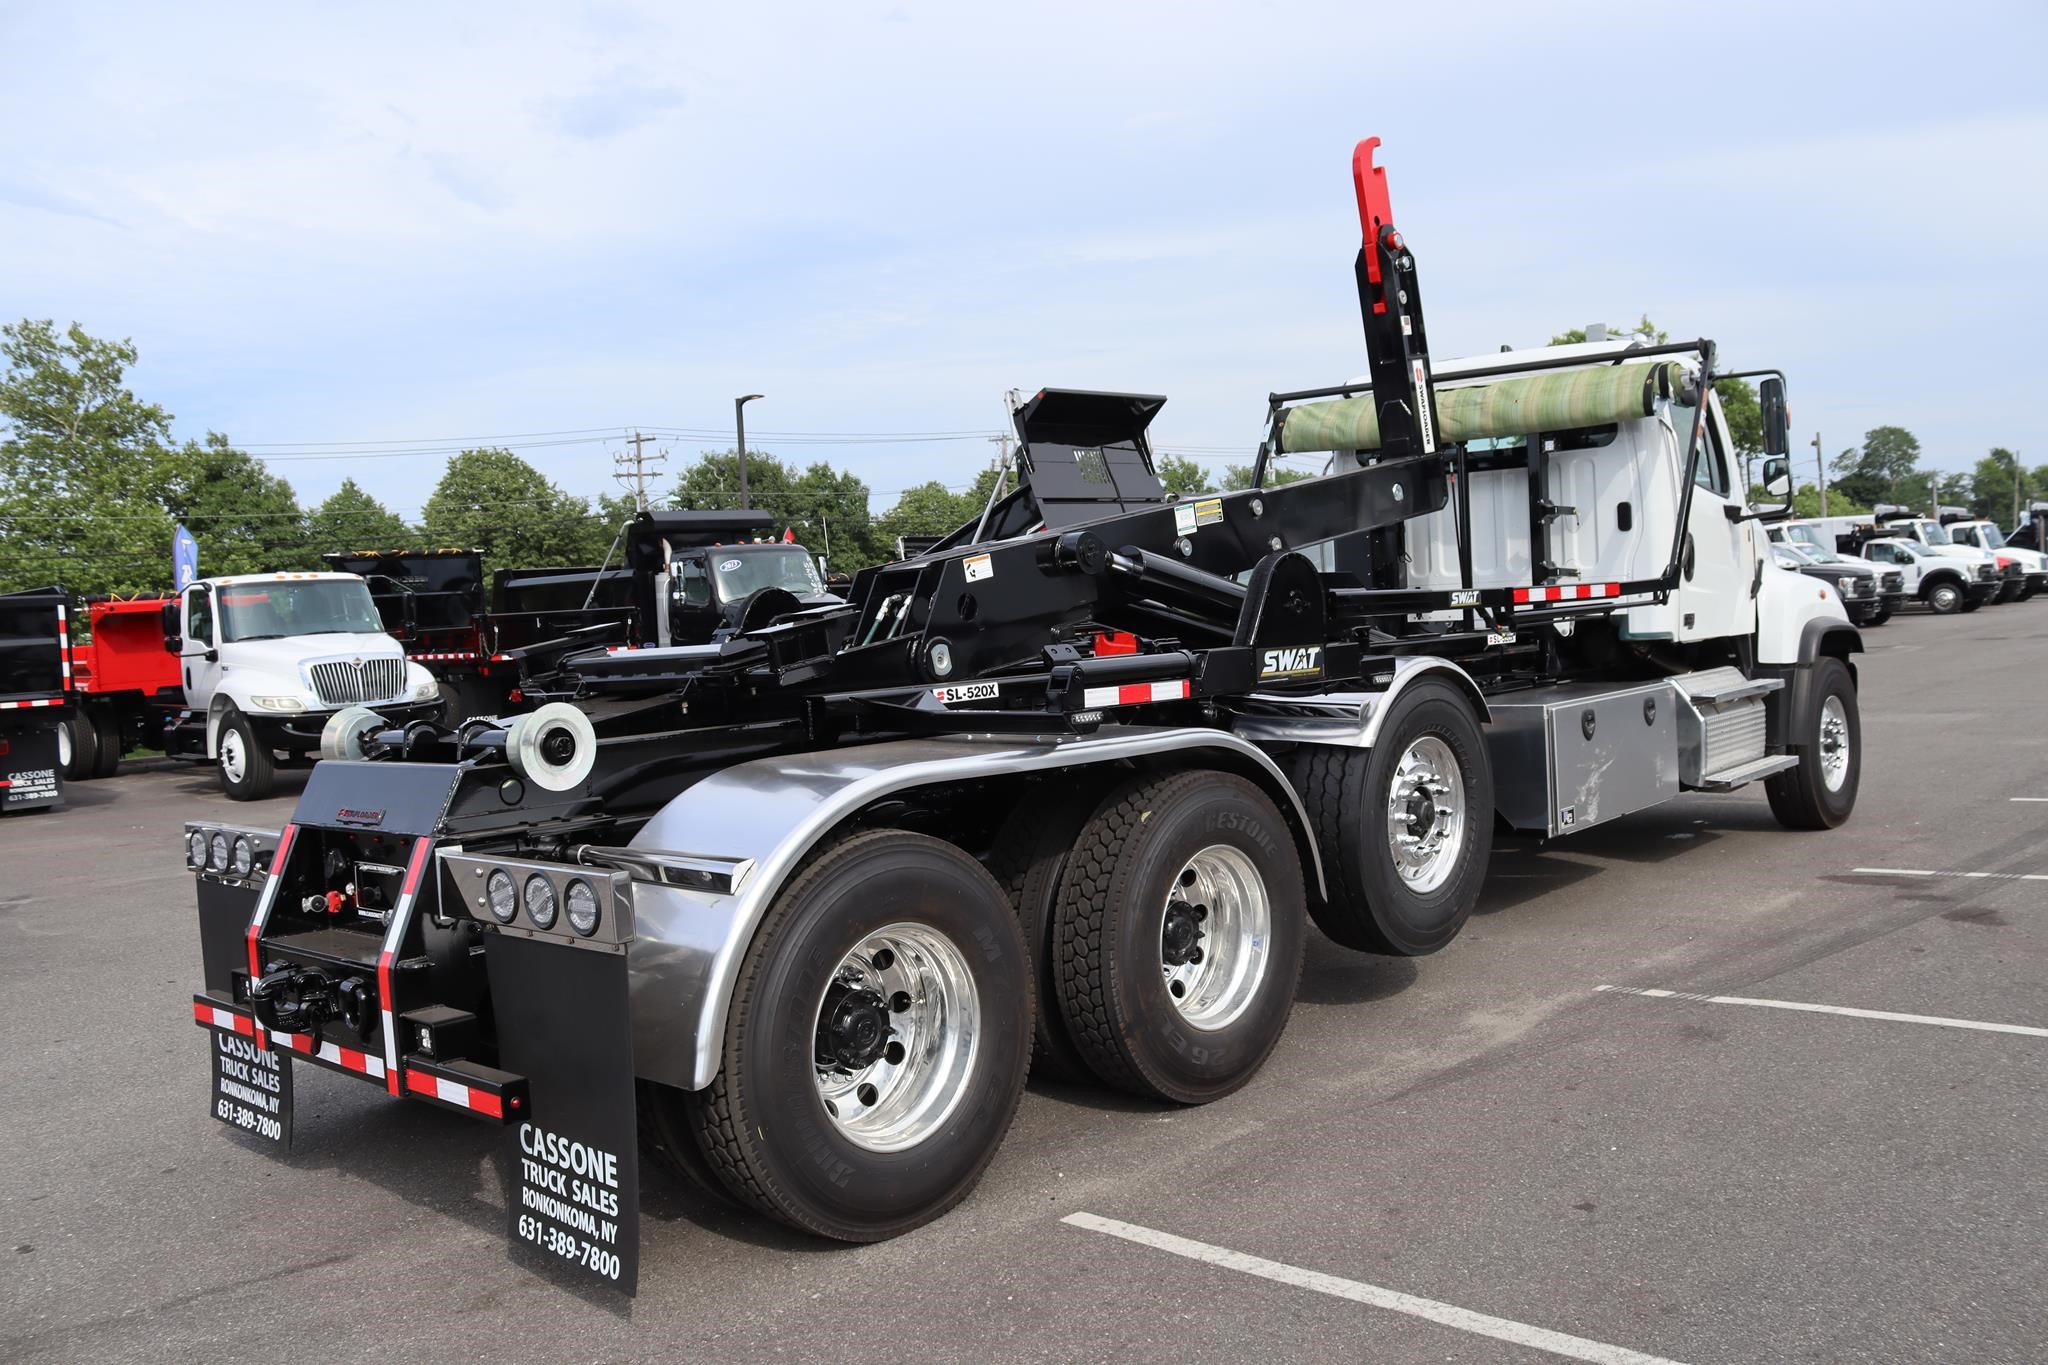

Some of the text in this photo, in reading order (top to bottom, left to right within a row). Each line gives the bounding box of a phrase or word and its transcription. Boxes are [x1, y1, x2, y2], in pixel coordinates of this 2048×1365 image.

[1451, 590, 1480, 605] SWAT
[1262, 646, 1321, 673] SWAT
[8, 769, 55, 780] CASSONE
[218, 1033, 279, 1071] CASSONE
[220, 1056, 280, 1092] TRUCK SALES
[218, 1099, 281, 1141] 631-389-7800
[269, 1096, 280, 1114] NY
[519, 1123, 619, 1189] CASSONE
[521, 1158, 619, 1217] TRUCK SALES
[522, 1186, 618, 1245] RONKONKOMA, NY
[518, 1214, 620, 1280] 631-389-7800
